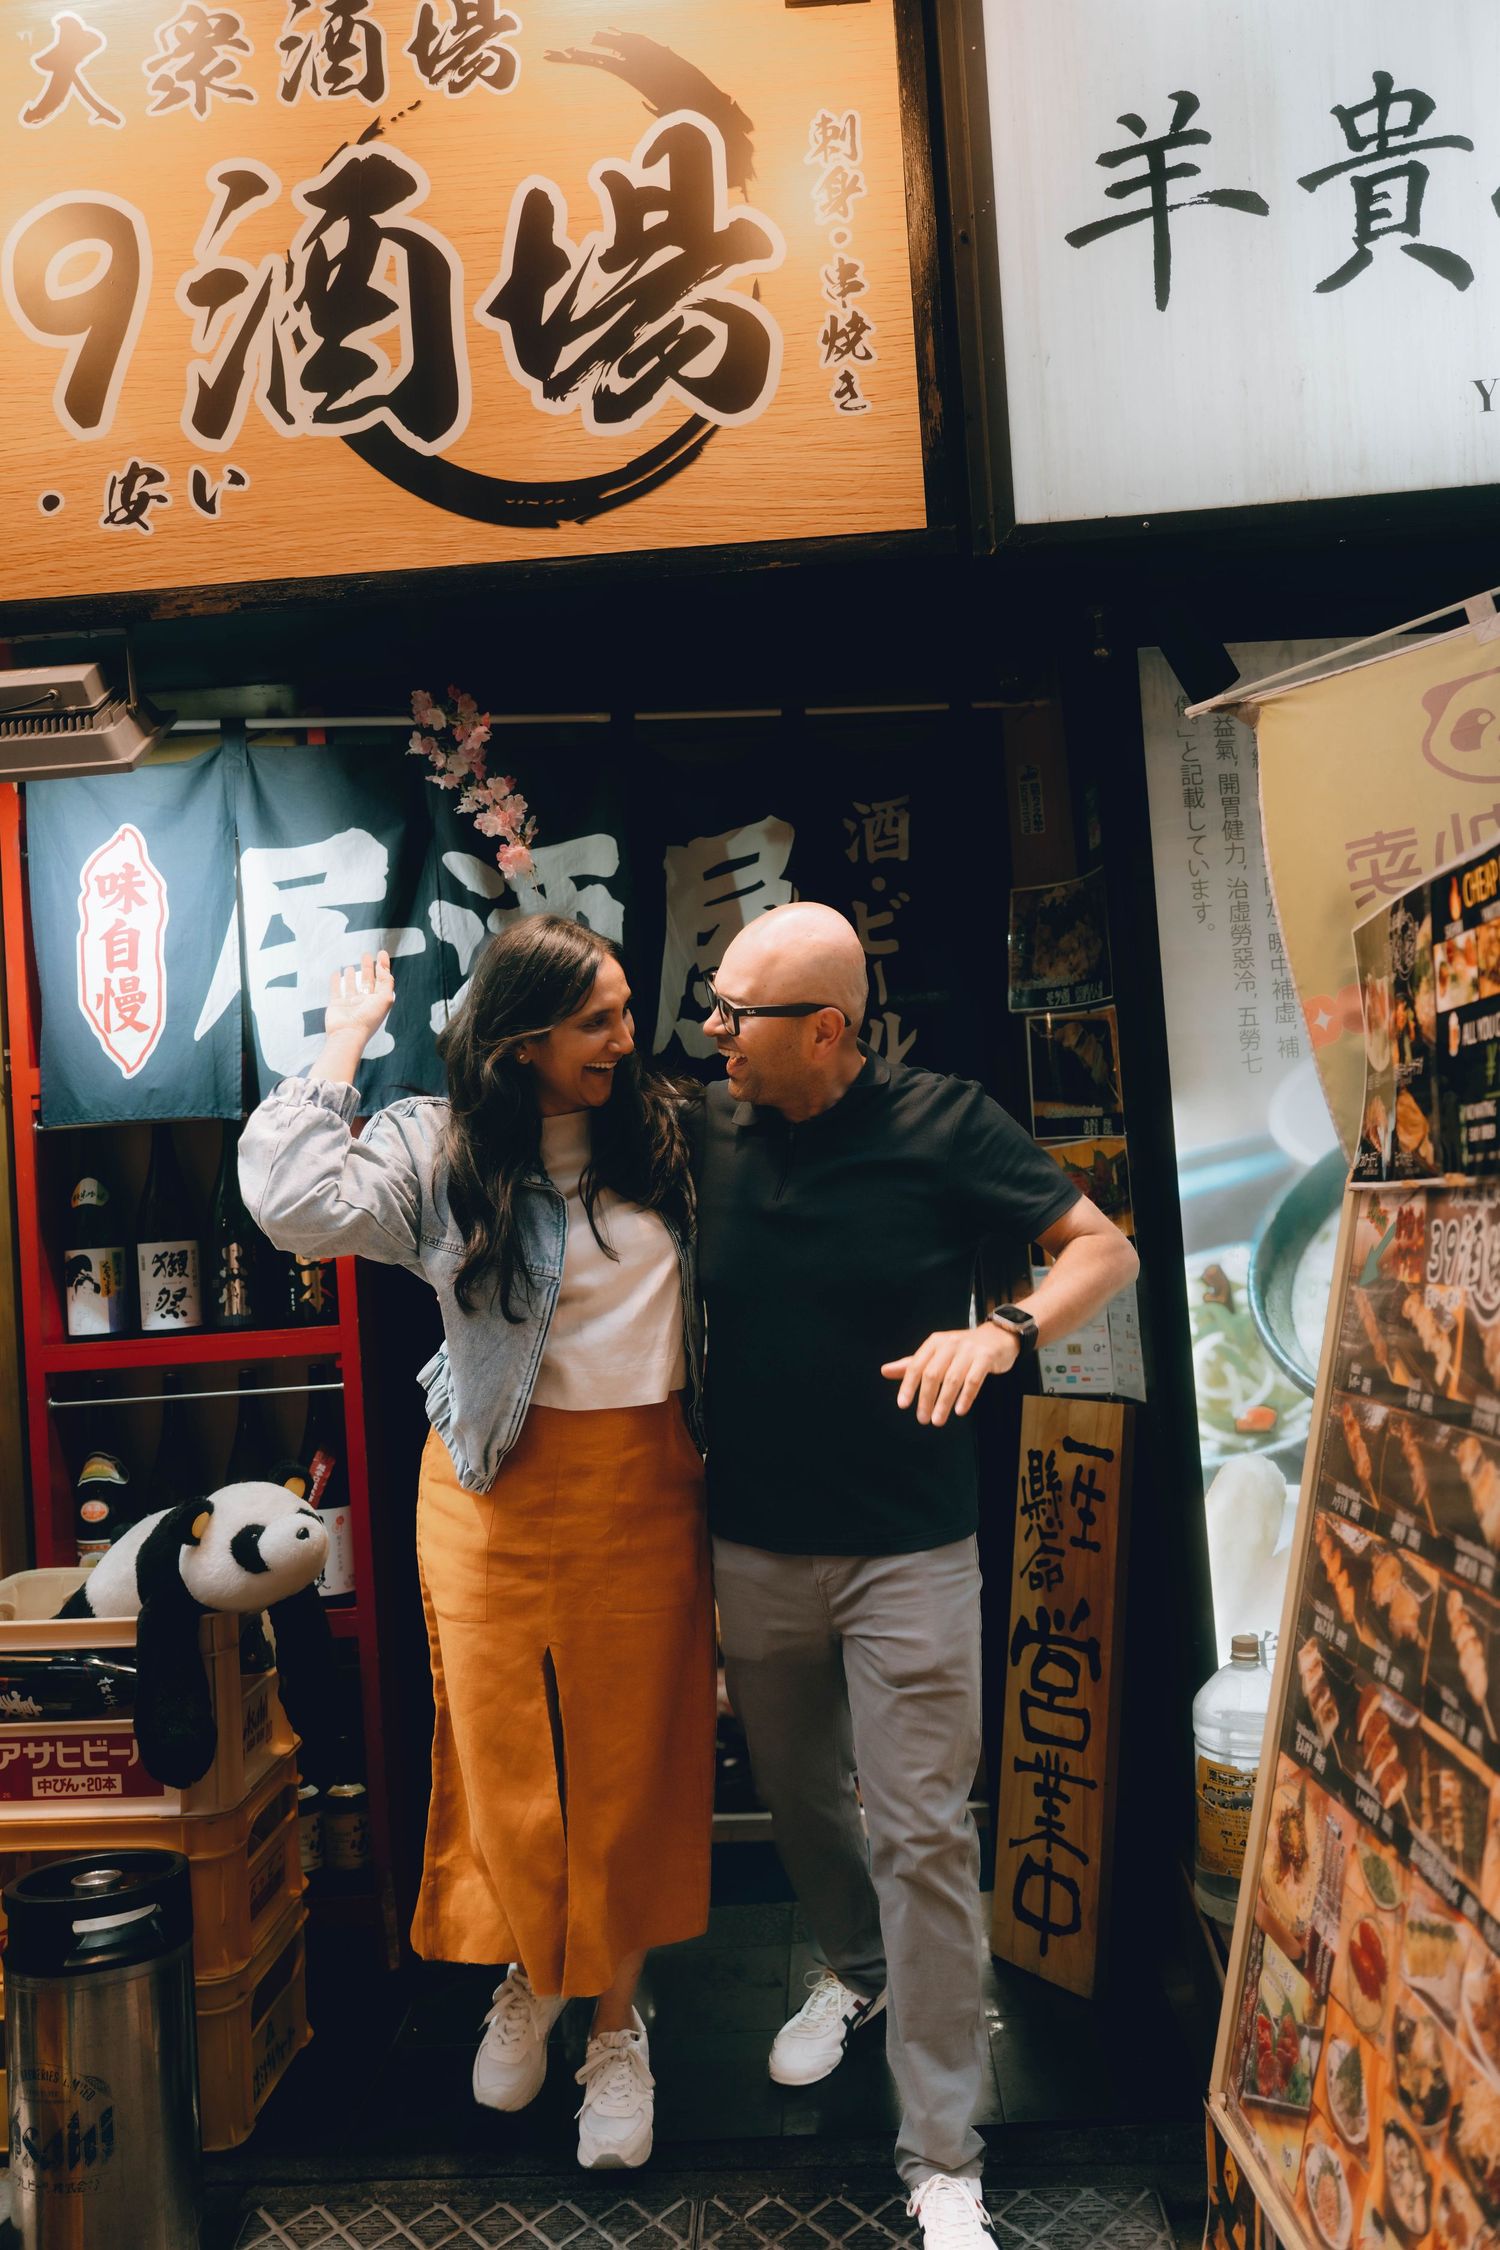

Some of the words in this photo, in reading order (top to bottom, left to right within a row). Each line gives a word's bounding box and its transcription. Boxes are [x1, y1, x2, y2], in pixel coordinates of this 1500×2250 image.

[22, 0, 518, 124] 大衆酒場
[10, 120, 772, 442] 9酒場
[810, 112, 874, 411] 刺身・串焼き
[1064, 70, 1500, 312] 羊貴
[94, 862, 151, 1034] 味自慢
[843, 795, 918, 1065] 酒・ビール
[152, 1250, 191, 1320] 獺祭
[37, 1776, 118, 1796] 中びん・20本
